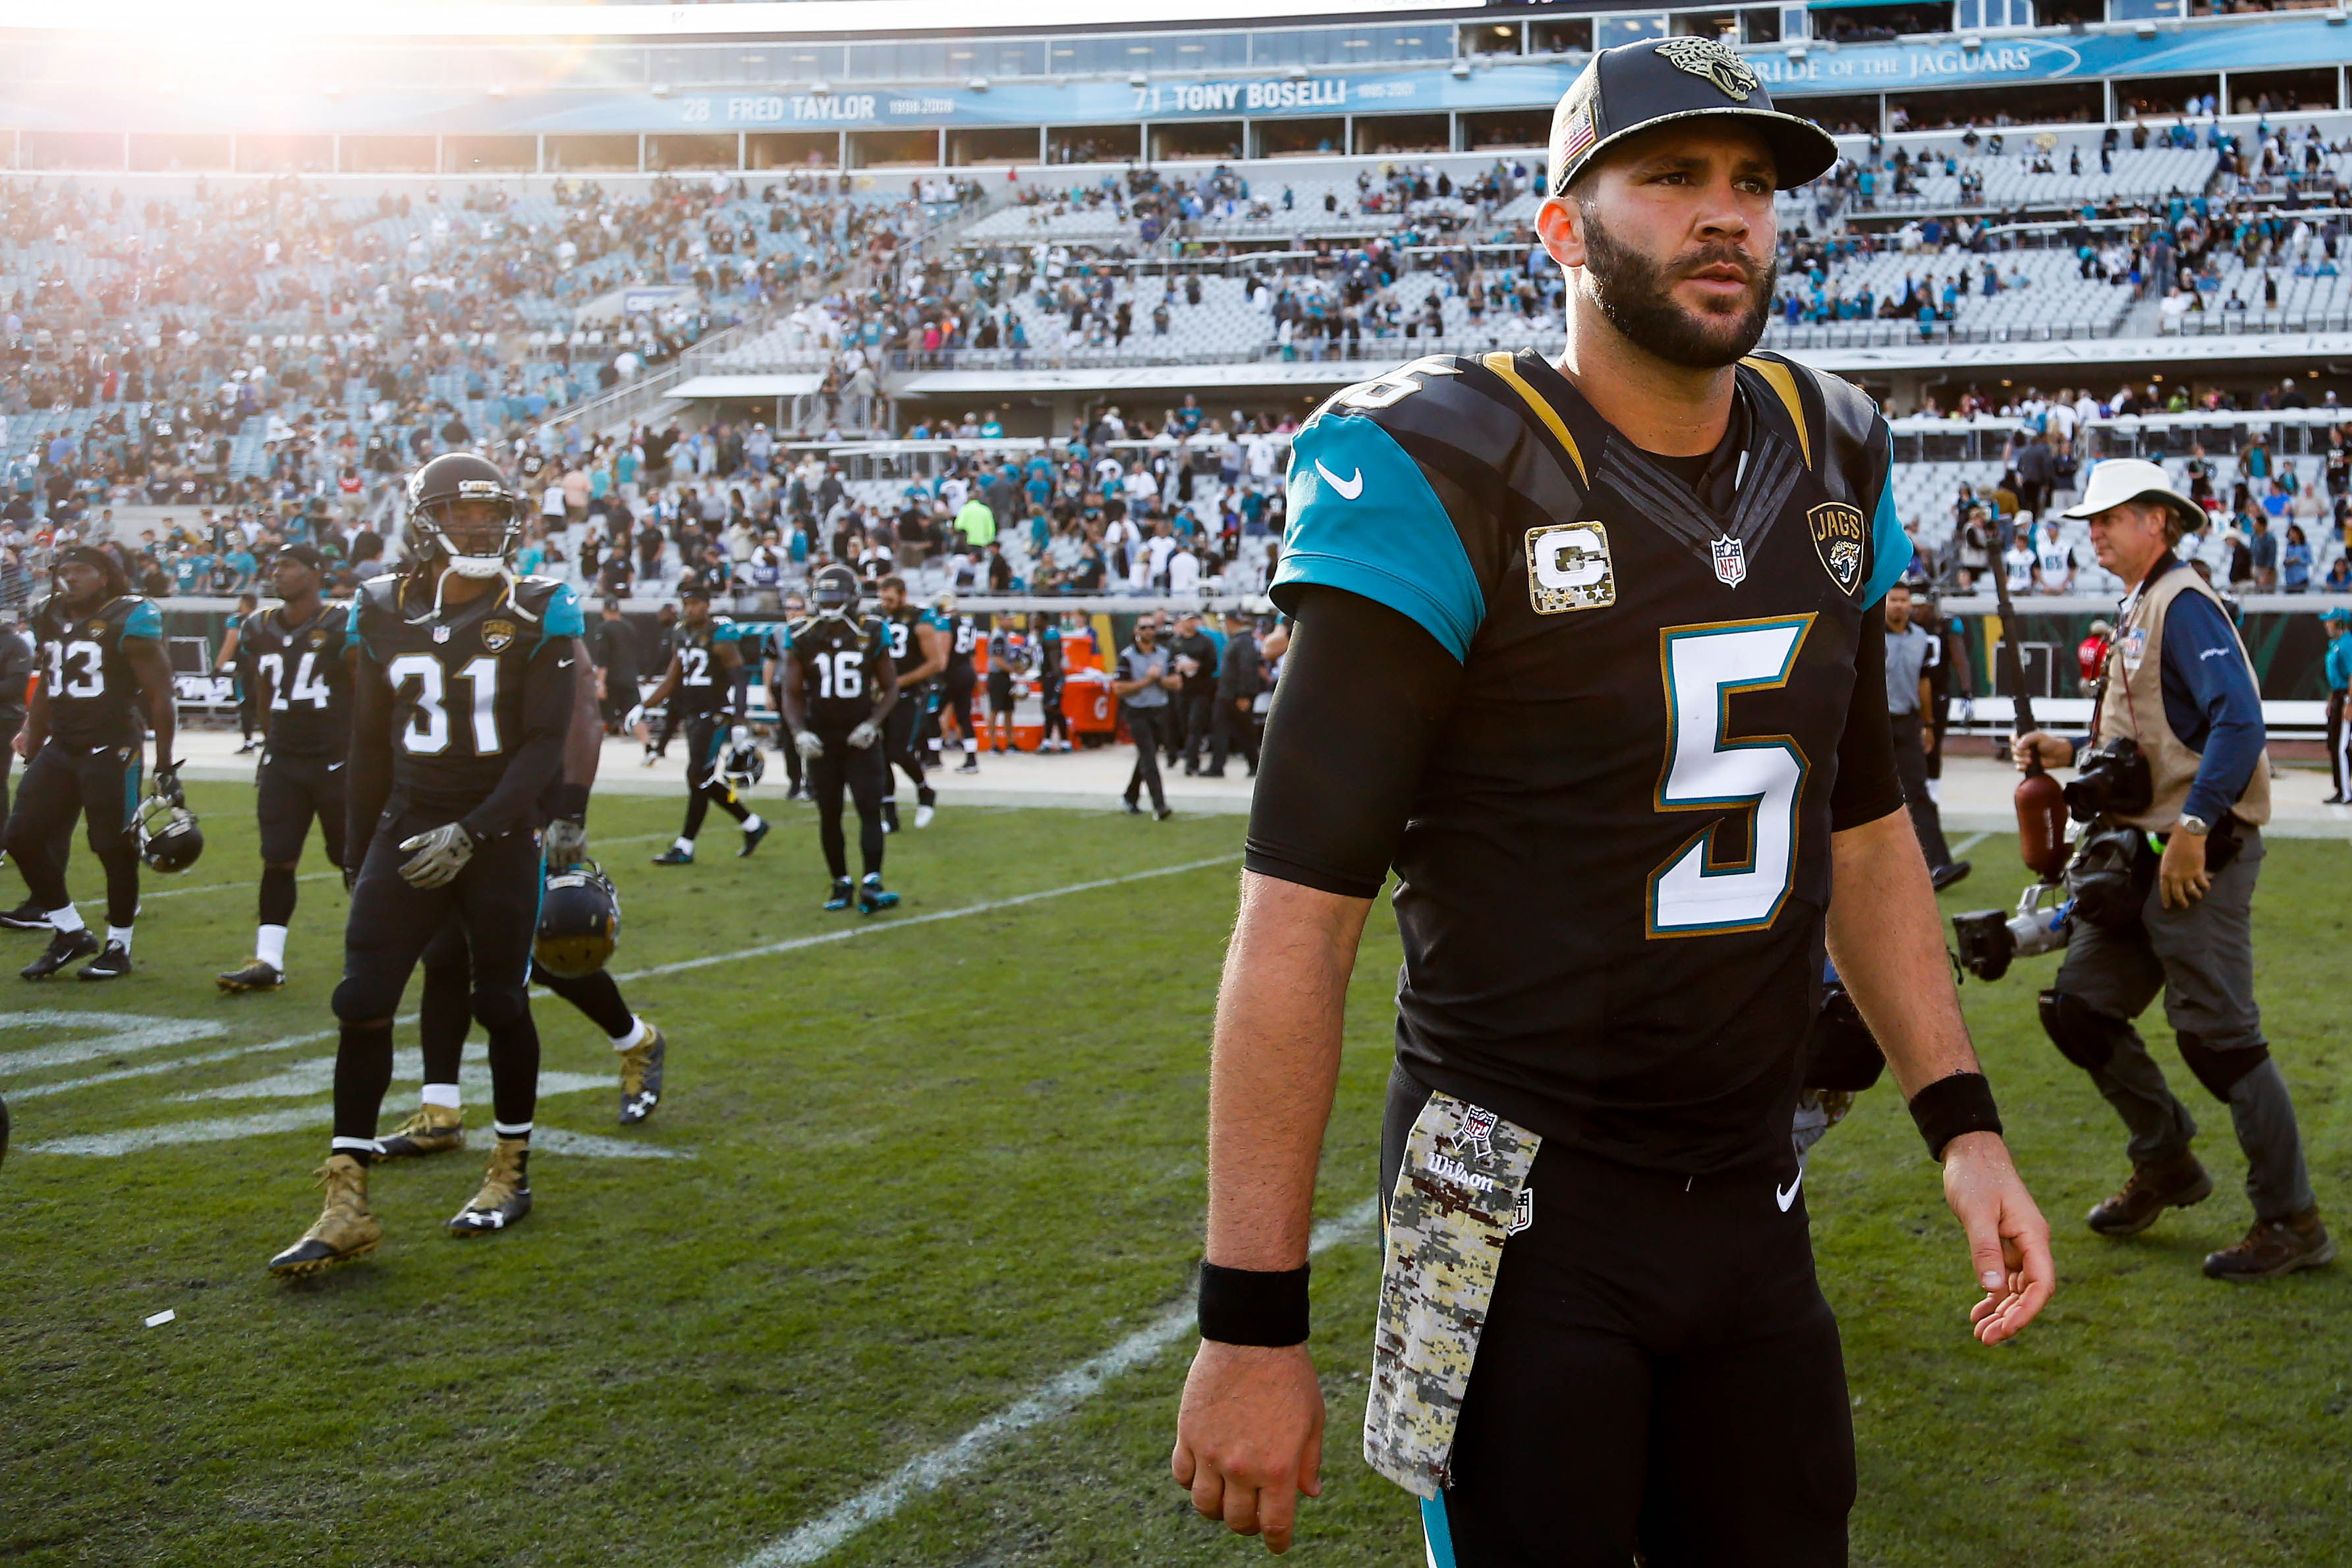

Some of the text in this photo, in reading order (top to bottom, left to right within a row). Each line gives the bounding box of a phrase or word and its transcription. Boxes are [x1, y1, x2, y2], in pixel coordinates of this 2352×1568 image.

[1749, 58, 1824, 82] RIDE
[1910, 47, 2030, 79] JAGUARS
[681, 97, 710, 123] 28
[727, 96, 784, 122] FRED
[791, 94, 876, 121] TAYLOR
[1131, 86, 1162, 112] 71
[1173, 84, 1241, 111] TONY
[1246, 78, 1346, 109] BOSELLI
[1817, 511, 1861, 542] JAGS
[1534, 529, 1604, 589] C
[1719, 557, 1742, 578] NFL
[889, 623, 909, 659] 3
[258, 651, 331, 711] 24
[812, 650, 864, 699] 16
[387, 651, 504, 758] 31
[1094, 695, 1108, 720] G
[1645, 611, 1818, 940] 5
[1465, 1120, 1490, 1137] NFL
[1426, 1152, 1494, 1194] Wilson
